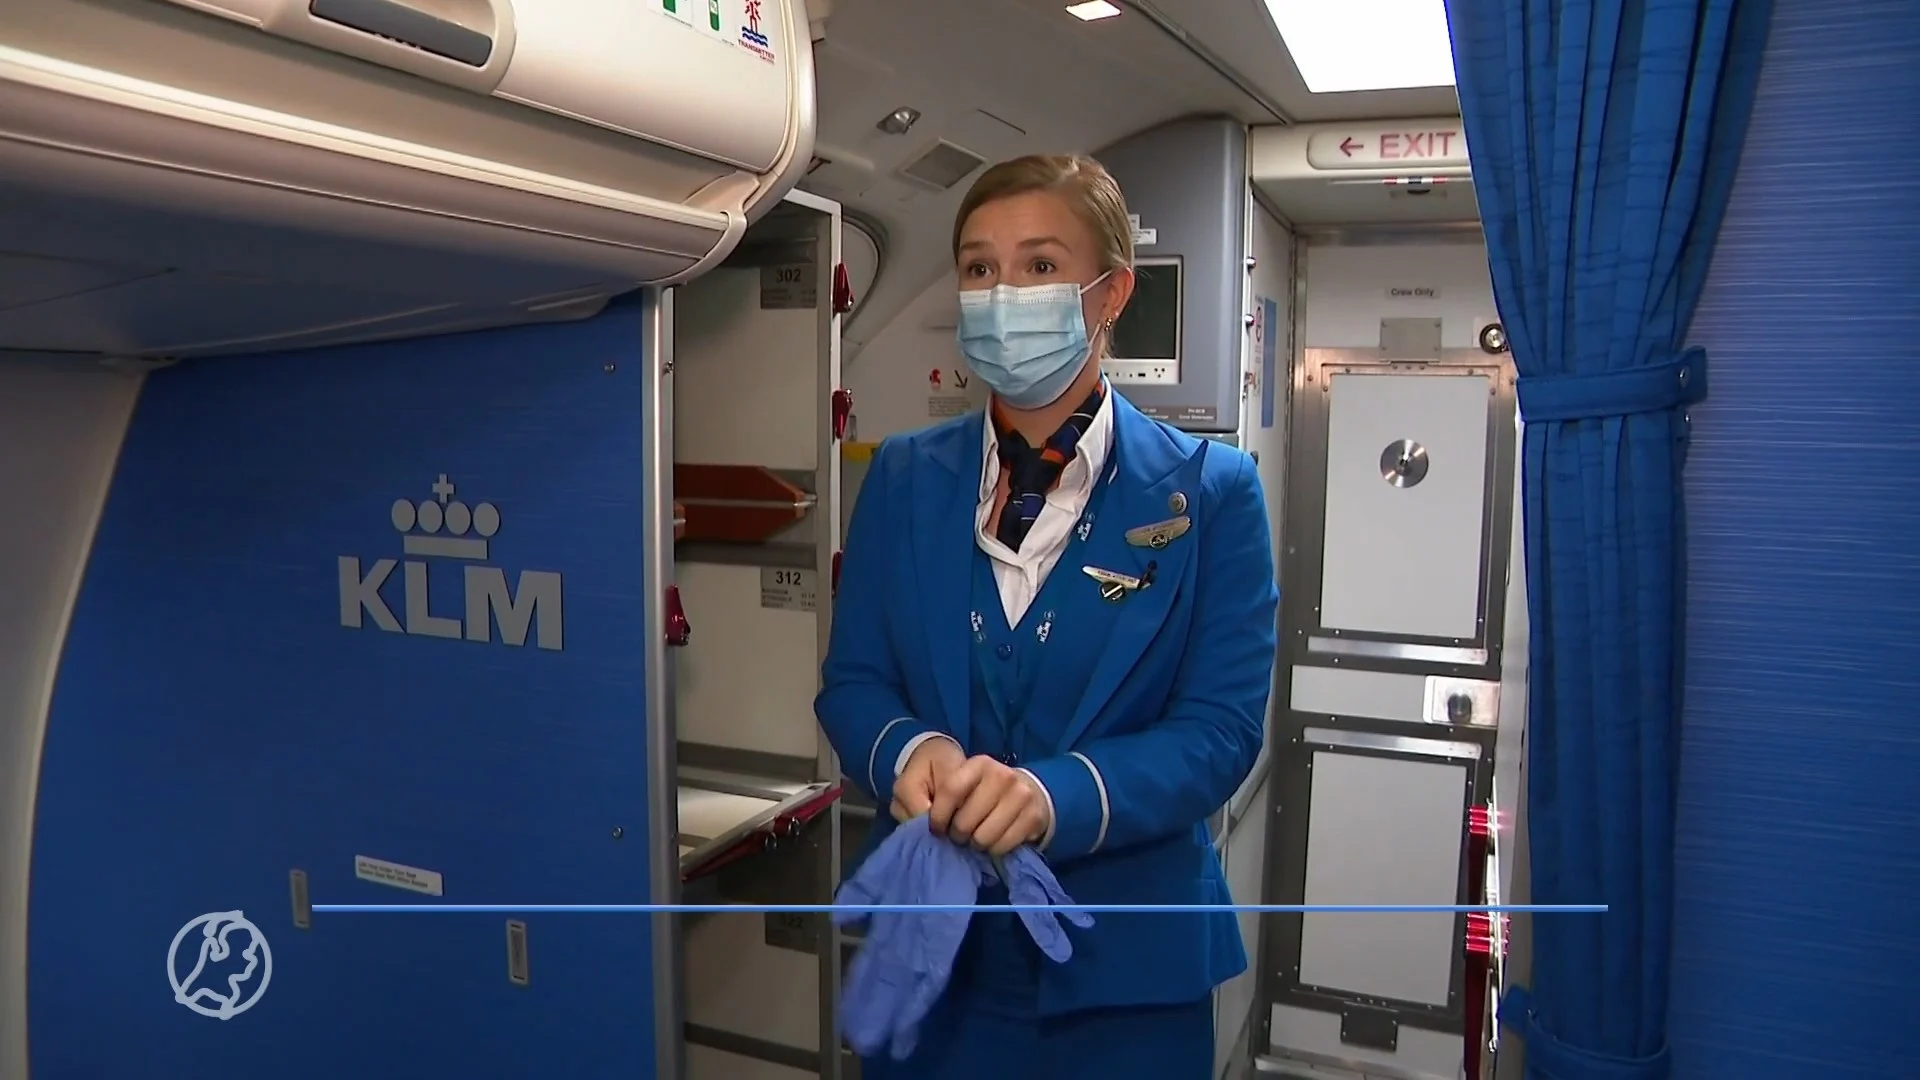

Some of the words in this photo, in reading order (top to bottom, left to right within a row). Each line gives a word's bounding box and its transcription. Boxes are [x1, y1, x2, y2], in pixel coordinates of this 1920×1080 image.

[1379, 131, 1457, 159] EXIT
[775, 268, 802, 284] 302
[775, 570, 802, 586] 312
[337, 555, 563, 651] KLM
